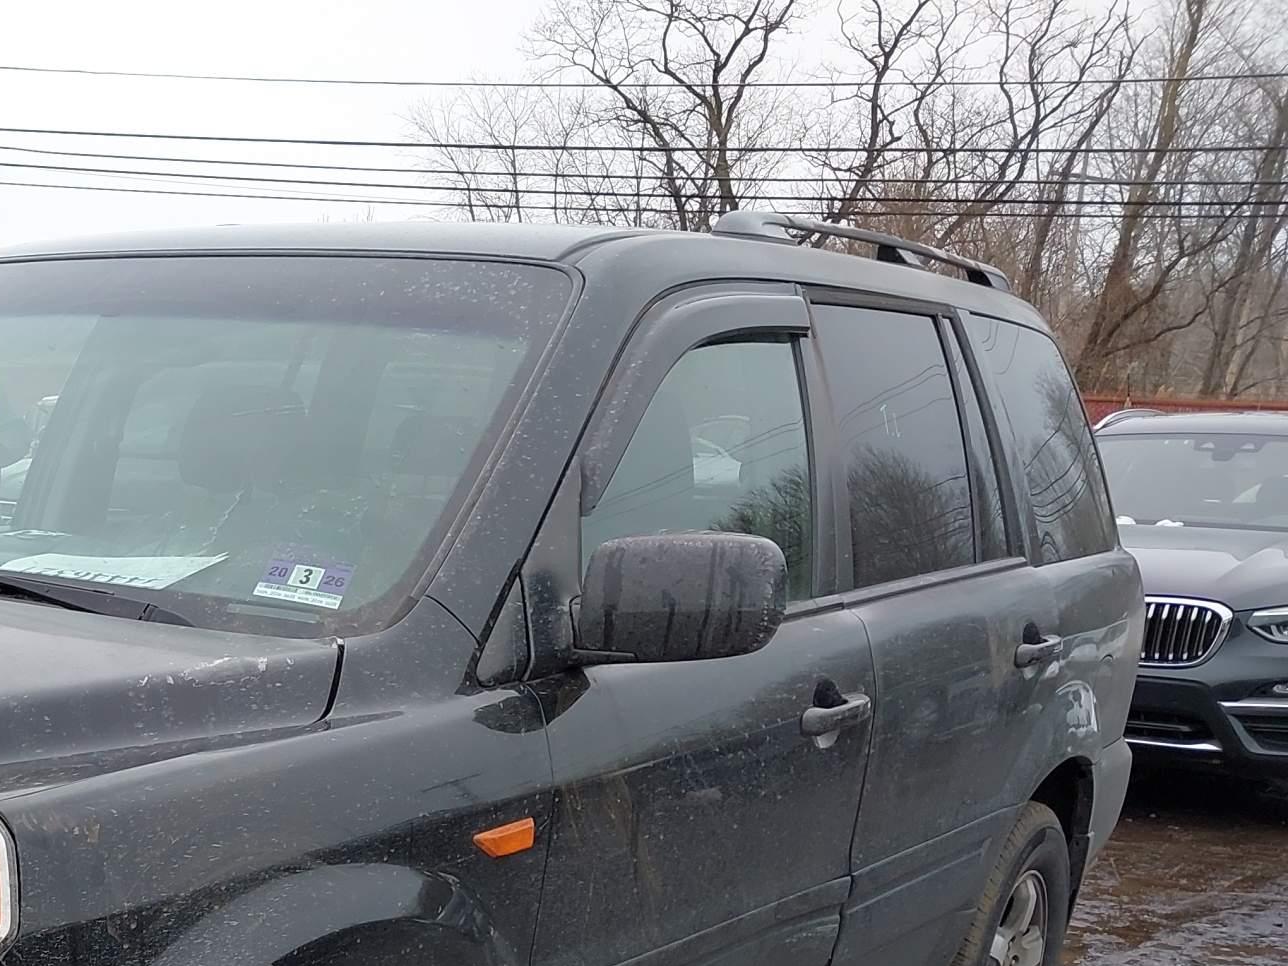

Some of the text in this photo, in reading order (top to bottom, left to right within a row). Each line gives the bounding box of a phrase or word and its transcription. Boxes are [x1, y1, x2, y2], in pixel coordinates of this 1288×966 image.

[267, 565, 345, 588] 20 3 26
